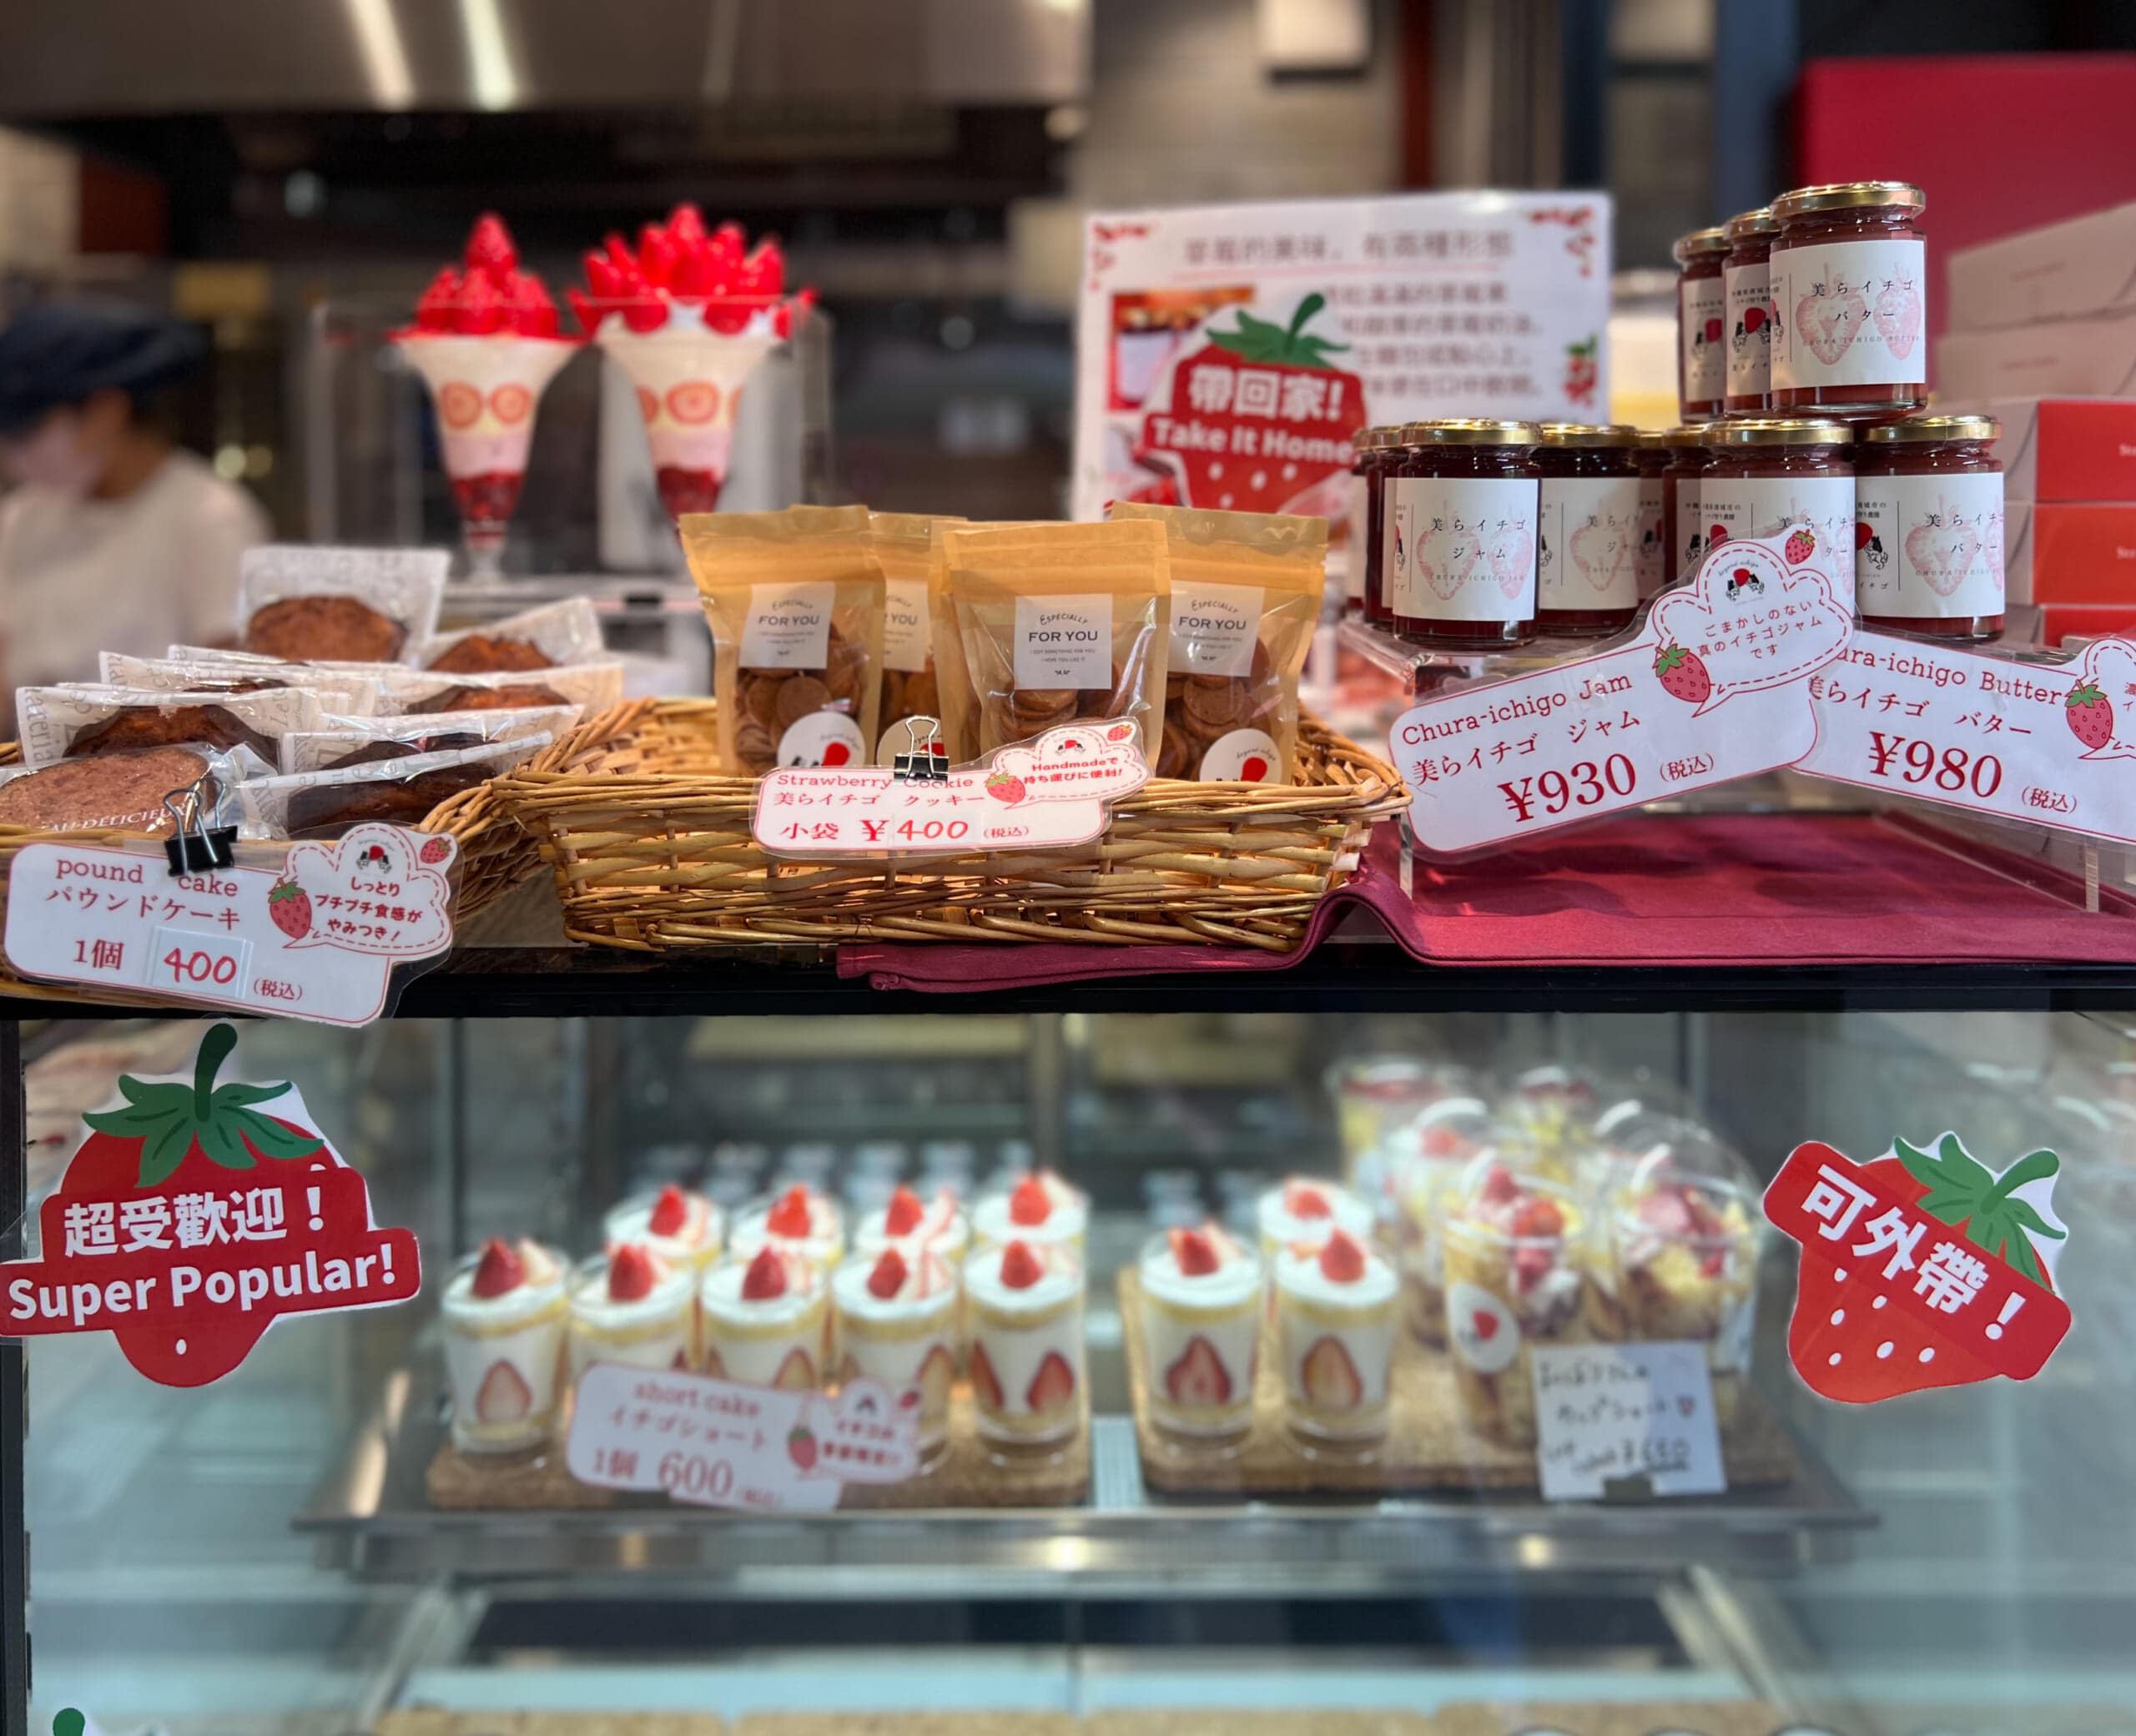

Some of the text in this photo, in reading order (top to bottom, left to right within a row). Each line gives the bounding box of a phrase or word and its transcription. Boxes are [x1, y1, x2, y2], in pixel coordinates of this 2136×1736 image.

[1812, 279, 1914, 296] 美らイチゴ
[1836, 309, 1895, 322] バター
[1188, 363, 1344, 422] 帶回家!
[1151, 417, 1227, 449] Take
[1231, 424, 1260, 452] It
[1431, 517, 1526, 532] 美らイチゴ
[1453, 546, 1505, 560] ジャム
[1951, 543, 1997, 553] バター
[1191, 600, 1238, 613] ESPECIALLY
[758, 615, 819, 626] FOR YOU
[891, 614, 918, 626] YOU
[1040, 613, 1088, 626] ESPECIALLY
[1179, 616, 1246, 630] FOR YOU
[1705, 600, 1812, 638] ごまかしのない
[1029, 631, 1098, 642] FOR YOU
[1697, 616, 1822, 657] 真のイチゴジャム
[1752, 643, 1778, 659] です
[1979, 671, 2063, 705] Butter
[1402, 675, 1632, 745] Chura-ichigo Jam
[1953, 712, 2032, 735] バター
[1412, 709, 1640, 786] 美らイチゴ ジャム
[1032, 756, 1118, 772] Handmadeで
[1868, 730, 2002, 798] ¥980
[777, 774, 974, 790] Strawberry Cookie
[1024, 768, 1123, 785] 持ち運びに便利!
[1498, 752, 1636, 824] ¥930
[773, 793, 985, 807] 美らイチゴ クッキー
[781, 822, 839, 841] 小袋
[56, 858, 239, 897] pound cake
[350, 878, 400, 898] しっとり
[46, 886, 240, 932] パウンドケーキ
[315, 893, 422, 924] プチプチ食感が
[327, 918, 400, 942] やみつき！
[73, 938, 124, 970] 1個
[164, 947, 237, 984] 400
[63, 1187, 325, 1257] 超受歡迎！
[1801, 1164, 2027, 1340] 可外帶！
[9, 1243, 396, 1326] Super Popular!
[634, 1381, 760, 1417] short cake
[658, 1451, 733, 1498] 600
